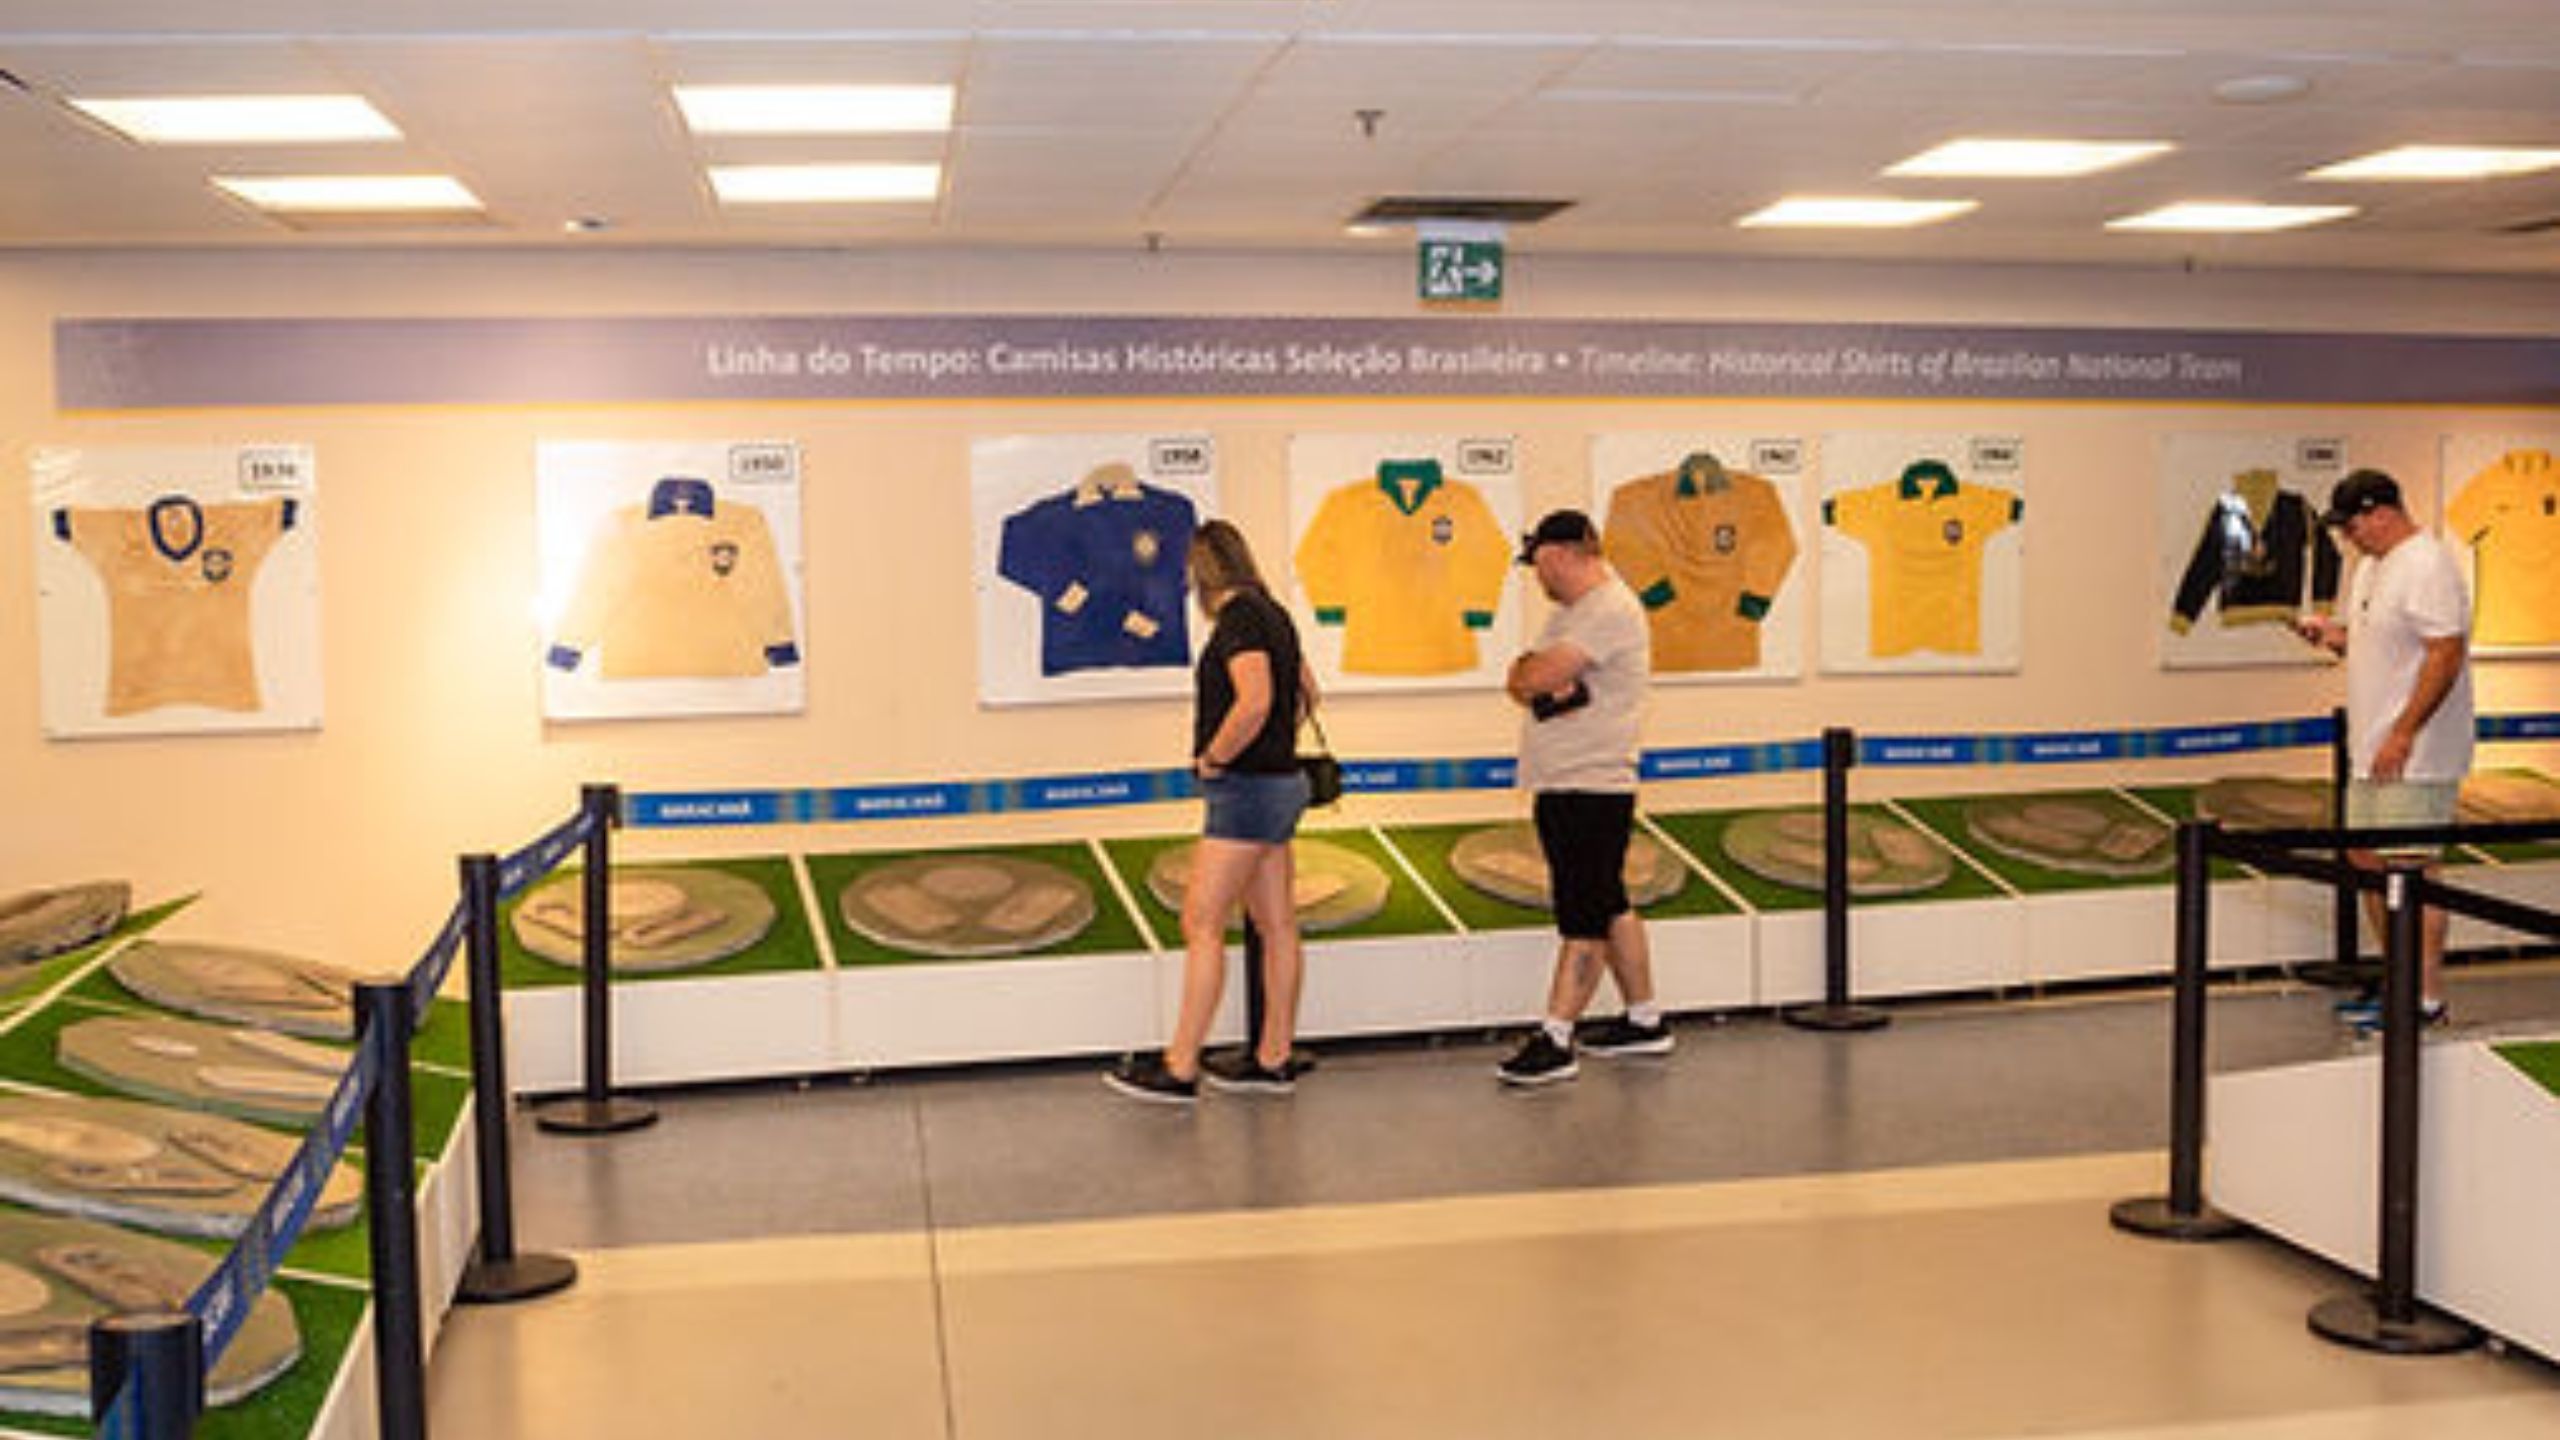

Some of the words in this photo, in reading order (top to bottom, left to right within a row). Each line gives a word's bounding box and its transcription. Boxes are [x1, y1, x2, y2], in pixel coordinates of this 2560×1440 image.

[707, 343, 799, 375] Linha
[808, 342, 850, 375] do
[860, 342, 981, 379] Tempo:
[986, 341, 1118, 374] Camisas
[1285, 341, 1401, 378] Seleção
[1410, 341, 1546, 375] Brasileira
[1918, 348, 1948, 384] of
